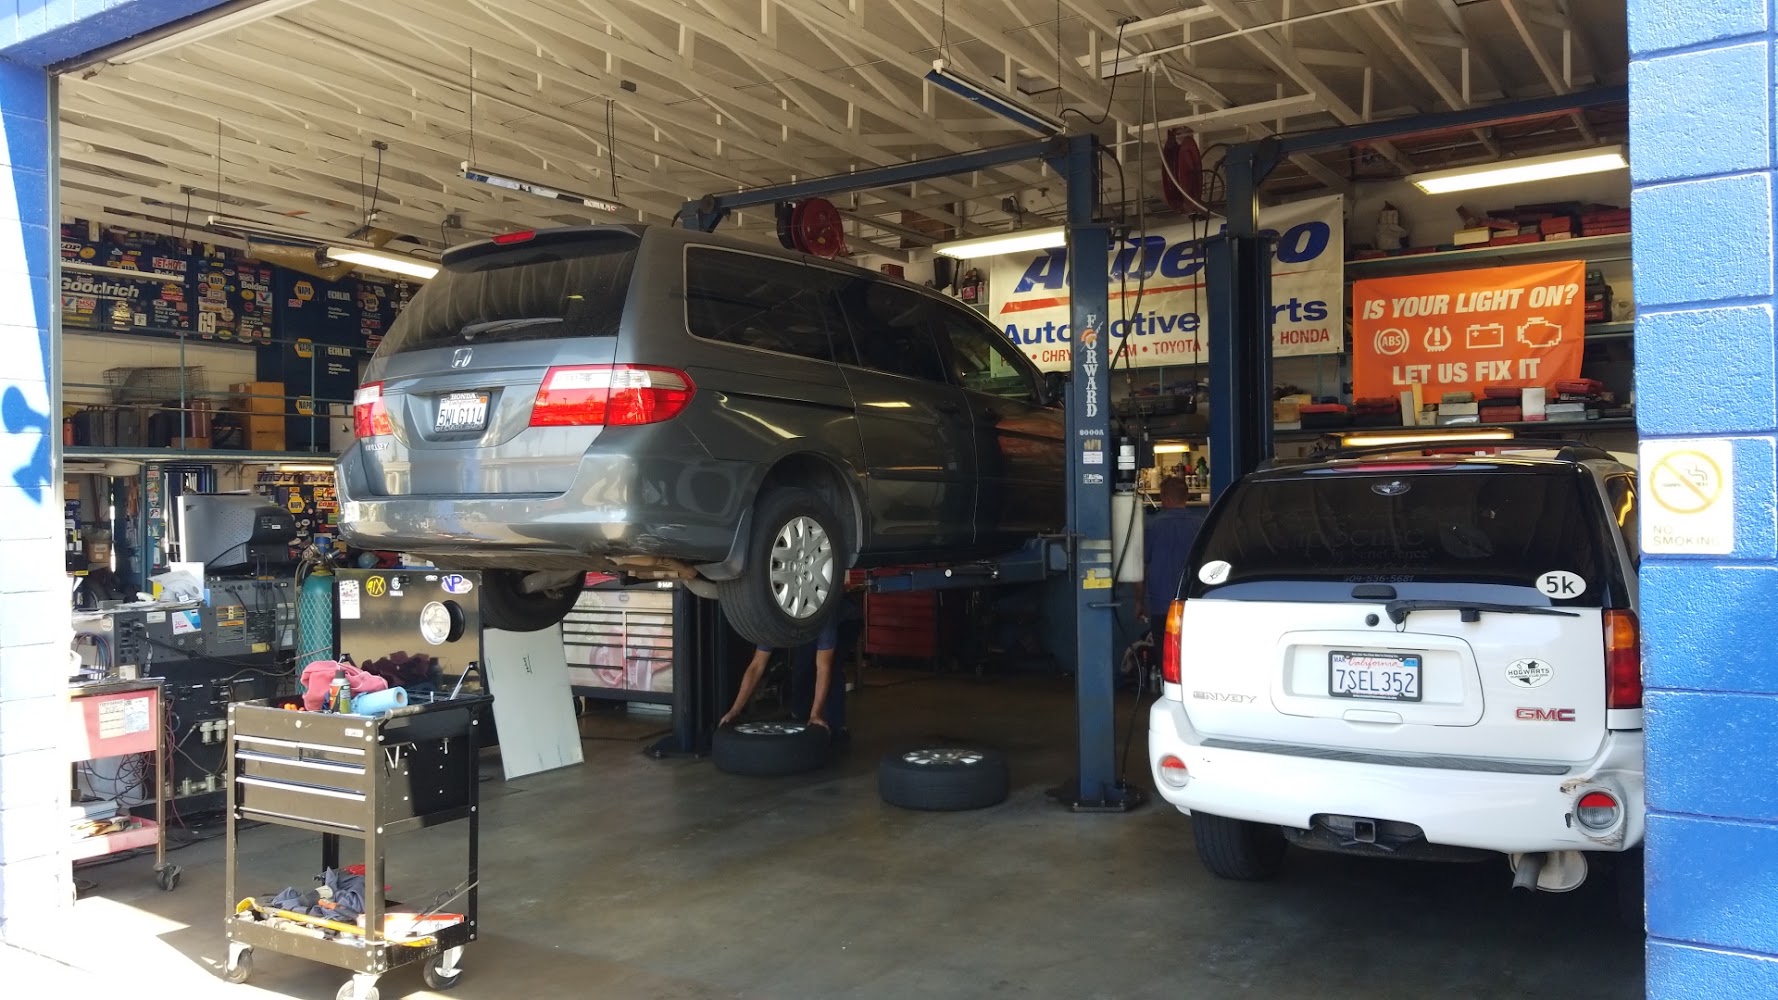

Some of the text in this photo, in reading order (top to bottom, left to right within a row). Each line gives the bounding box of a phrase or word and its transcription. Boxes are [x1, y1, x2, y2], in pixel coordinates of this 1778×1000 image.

[1014, 221, 1330, 293] ADeo
[241, 281, 269, 291] Belden
[1362, 283, 1579, 320] IS YOUR LIGHT ON?
[199, 312, 216, 333] 69
[1004, 311, 1201, 345] Autootive
[1153, 339, 1202, 355] TOYOTA
[1280, 328, 1330, 344] HONDA
[1382, 336, 1401, 346] ABS
[1083, 314, 1099, 418] FORWARD
[1392, 358, 1541, 385] LET US FIX IT
[1653, 525, 1672, 535] NO
[1546, 576, 1575, 594] 5k
[1348, 657, 1399, 670] California
[1335, 669, 1415, 694] 7SEL352
[1193, 691, 1258, 704] ENVOY
[1516, 708, 1576, 722] GMC
